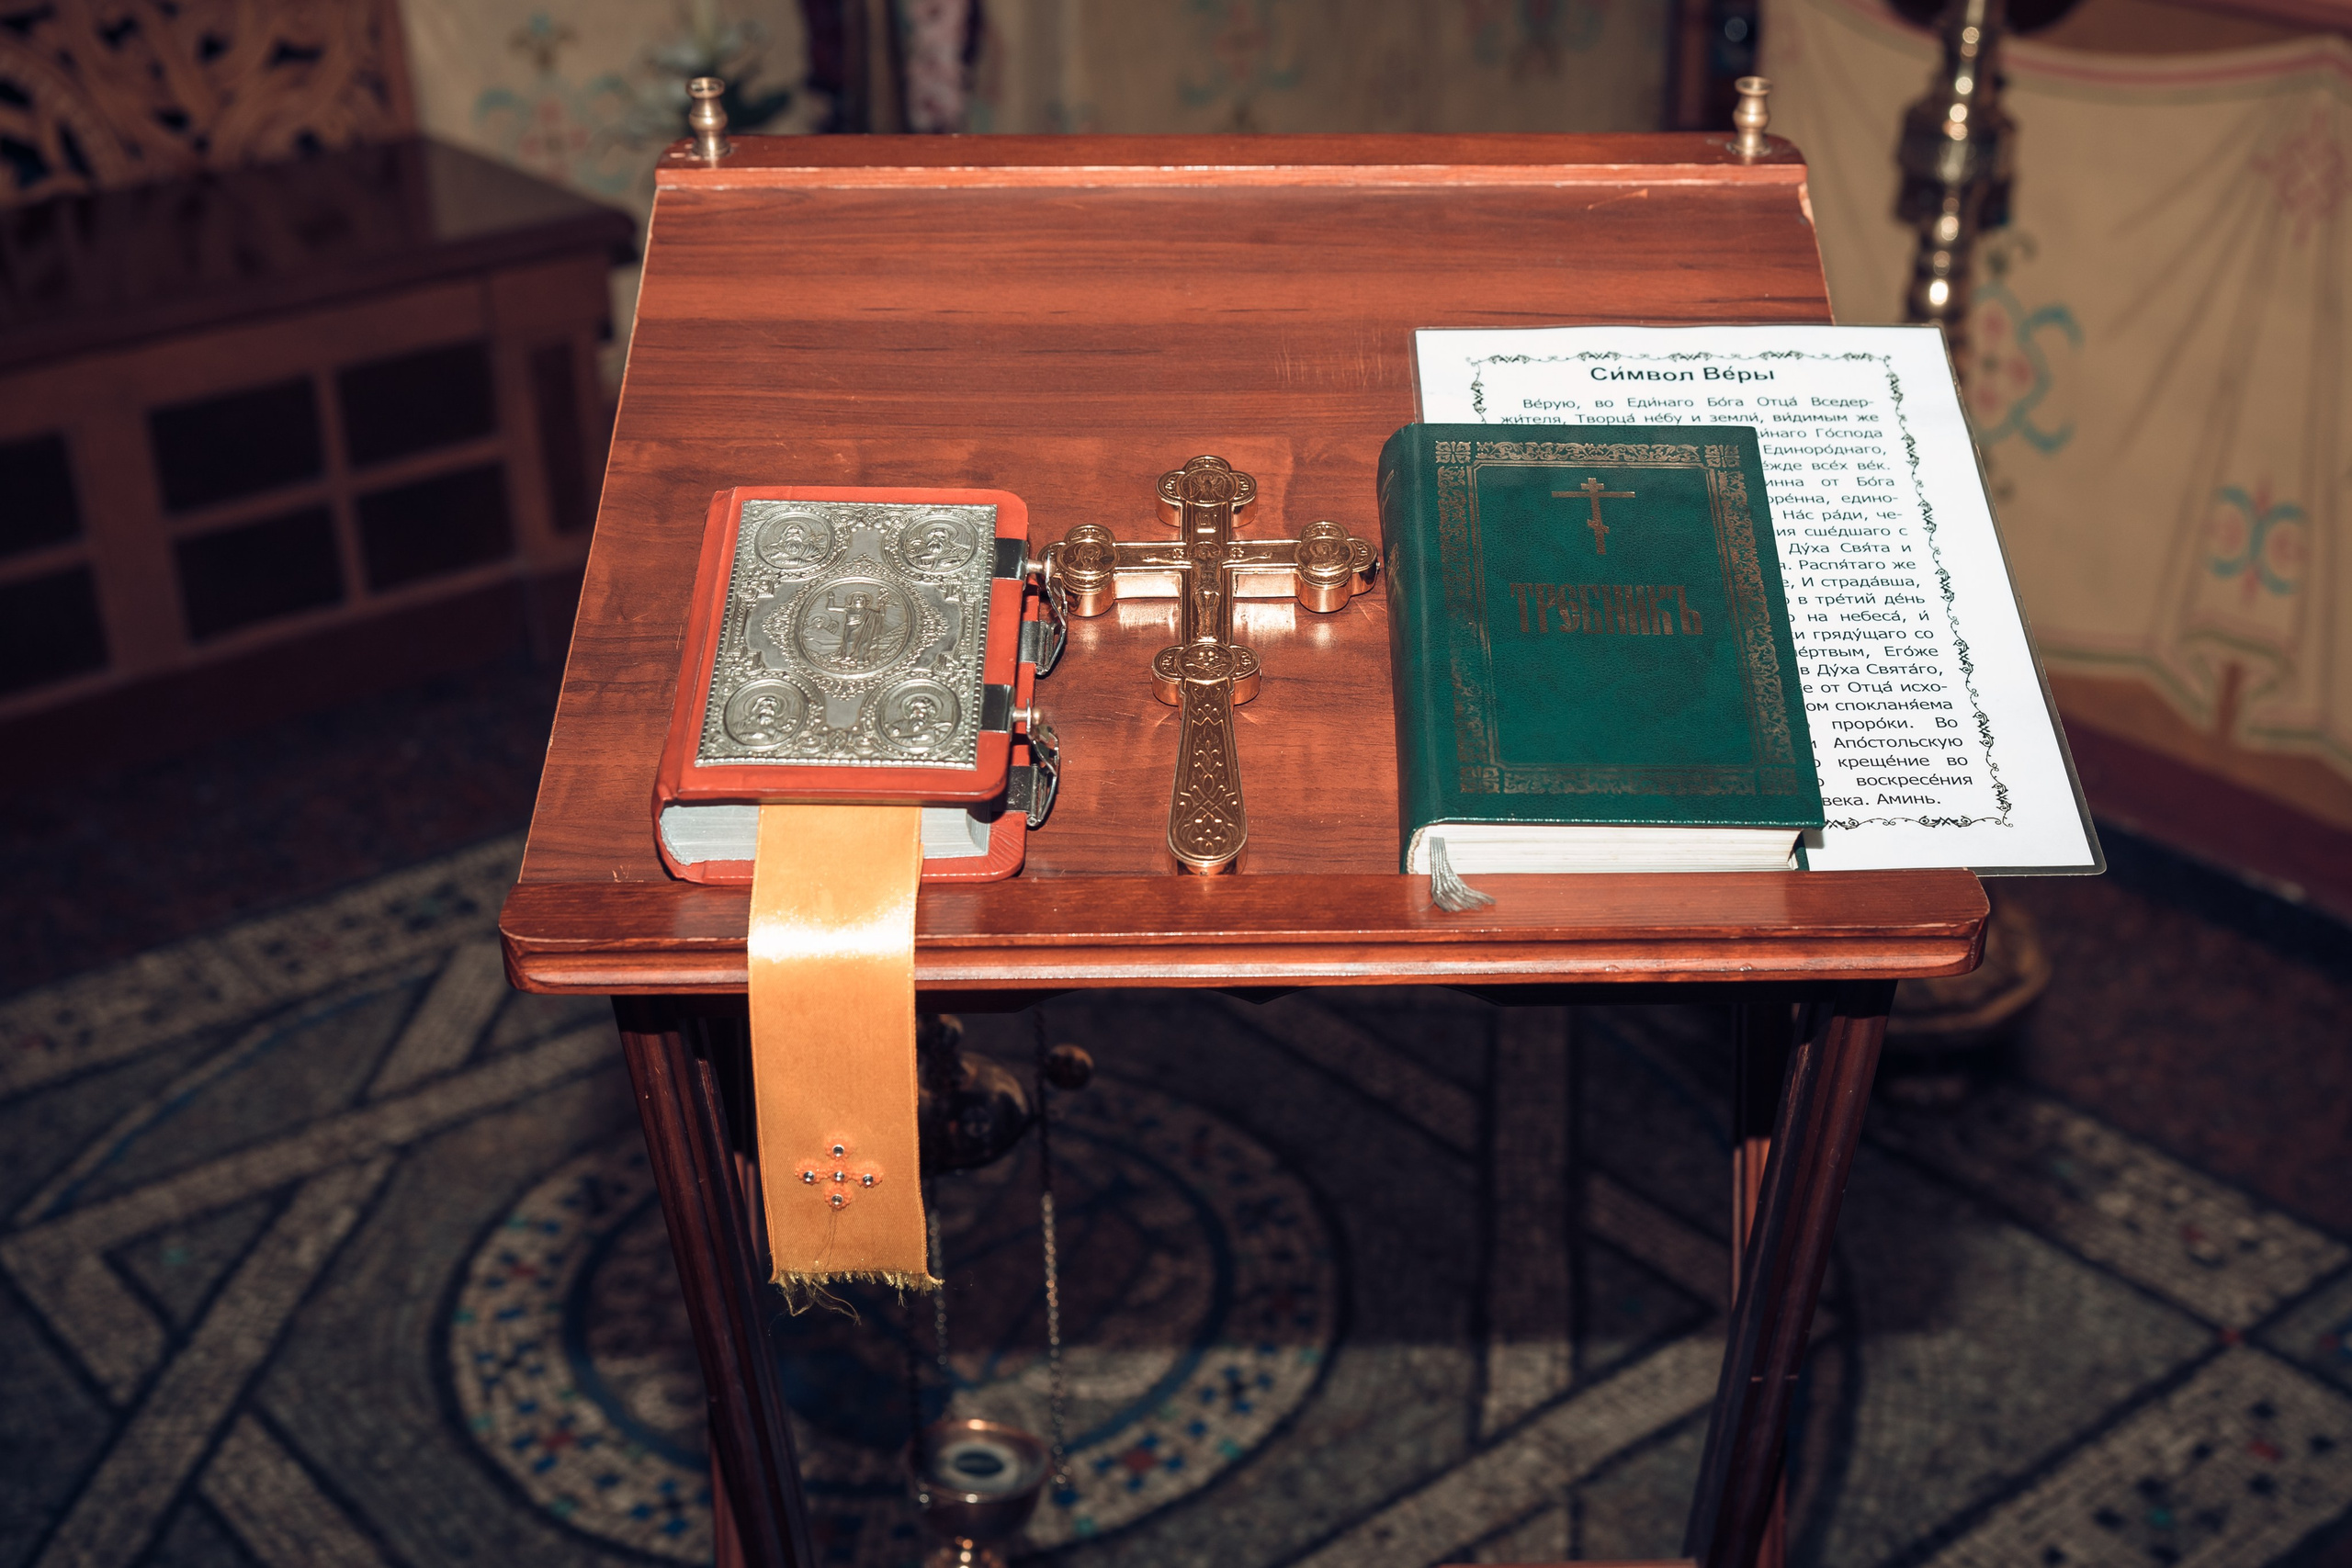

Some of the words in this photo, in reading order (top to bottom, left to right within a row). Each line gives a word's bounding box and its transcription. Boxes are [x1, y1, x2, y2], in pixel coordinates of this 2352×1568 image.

[1590, 367, 1695, 382] Си́мвол
[1703, 366, 1774, 383] Ве́ры
[1523, 399, 1579, 410] Ве́рую,
[1628, 398, 1693, 408] Еди́наго
[1708, 398, 1744, 406] Бо́га
[1758, 397, 1797, 407] Отца́
[1808, 396, 1874, 408] Вседер-
[1500, 414, 1566, 425] жи́теля,
[1576, 413, 1634, 424] Творца́
[1645, 413, 1681, 423] не́бу
[1711, 412, 1763, 423] земли́,
[1773, 412, 1848, 423] ви́димым
[1816, 428, 1883, 438] Го́спода
[1763, 445, 1885, 456] Единоро́днаго,
[1812, 460, 1848, 469] все́х
[1858, 460, 1889, 469] ве́к.
[1857, 477, 1894, 486] Бо́га
[1841, 495, 1897, 503] едино-
[1783, 510, 1814, 519] На́с
[1822, 510, 1867, 522] ра́ди,
[1877, 512, 1903, 520] че-
[1804, 526, 1890, 537] сше́дшаго
[1789, 543, 1829, 555] Ду́ха
[1840, 542, 1890, 552] Свя́та
[1799, 559, 1885, 570] Распя́таго
[1802, 577, 1814, 587] И
[1821, 576, 1919, 589] страда́вша,
[1815, 593, 1875, 606] тре́тий
[1884, 593, 1925, 605] де́нь
[1808, 614, 1827, 622] на
[1840, 610, 1905, 623] небеса́,
[1814, 628, 1906, 641] гряду́щаго
[1915, 630, 1933, 638] со
[1795, 646, 1871, 660] е́ртвым,
[1884, 646, 1939, 657] Его́же
[1817, 664, 1860, 677] Ду́ха
[1867, 663, 1942, 676] Свята́го,
[1821, 684, 1839, 693] от
[1848, 682, 1893, 694] Отца́
[1901, 683, 1947, 692] исхо-
[1836, 699, 1952, 711] спокланя́ема
[1832, 717, 1913, 732] проро́ки.
[1935, 717, 1958, 728] Во
[1834, 737, 1962, 750] Апо́стольскую
[1838, 755, 1929, 770] креще́ние
[1947, 757, 1968, 765] во
[1857, 773, 1973, 787] воскресе́ния
[1877, 794, 1940, 805] Аминь.
